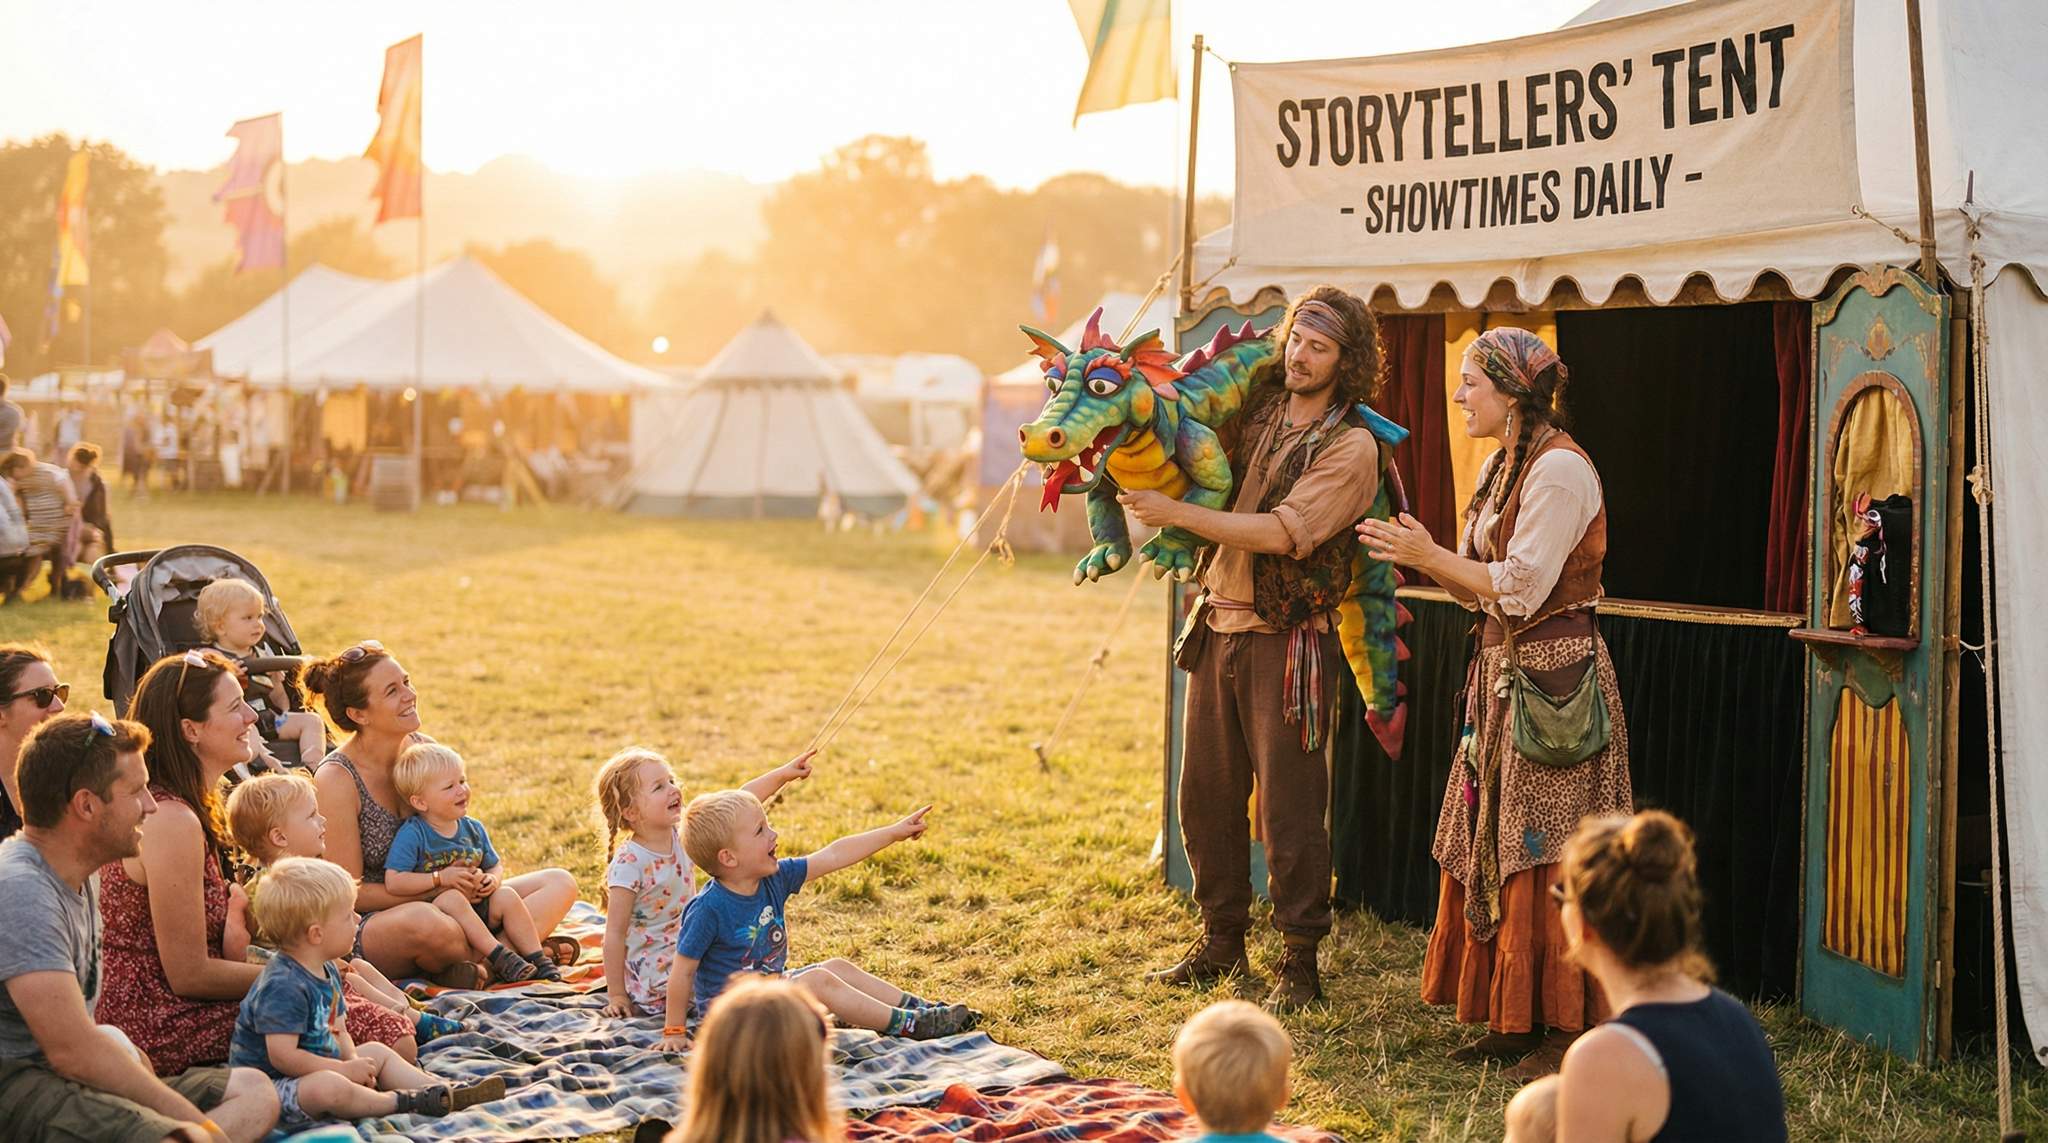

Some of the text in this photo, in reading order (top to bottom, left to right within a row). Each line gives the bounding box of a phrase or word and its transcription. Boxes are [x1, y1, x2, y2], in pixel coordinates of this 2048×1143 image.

[1276, 23, 1795, 169] STORYTELLERS’ TENT
[1365, 171, 1561, 235] SHOWTIMES
[1573, 153, 1674, 220] DAILY
